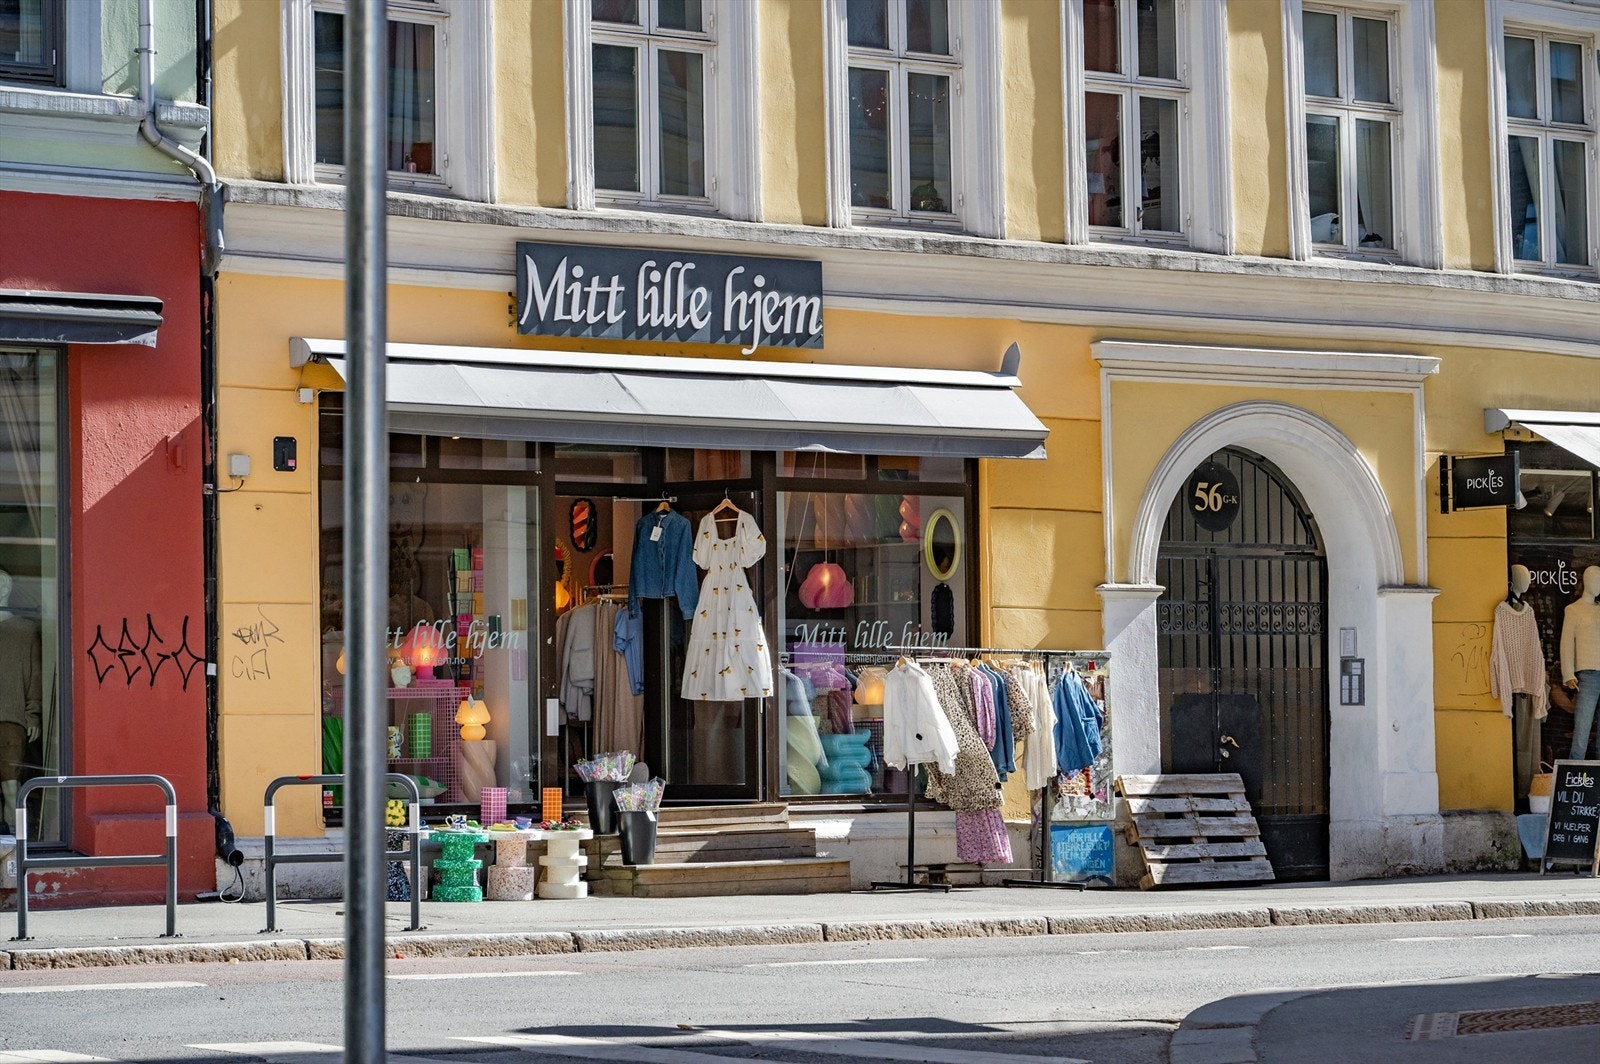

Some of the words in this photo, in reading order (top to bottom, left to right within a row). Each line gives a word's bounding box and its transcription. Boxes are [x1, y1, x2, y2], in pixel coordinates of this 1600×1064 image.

[520, 254, 626, 325] Mitt
[637, 260, 712, 329] lille
[723, 266, 823, 355] hjem
[1466, 469, 1504, 495] PICKLES
[1194, 482, 1223, 512] 56
[412, 619, 457, 650] lille
[465, 619, 521, 659] hjem
[794, 622, 847, 649] Mitt
[854, 620, 894, 649] lille
[1557, 790, 1569, 803] VIL
[1572, 790, 1585, 804] DU
[1553, 833, 1565, 842] DEG
[1573, 835, 1589, 844] GANG
[1554, 822, 1561, 830] VI
[1563, 823, 1591, 833] HJELPER
